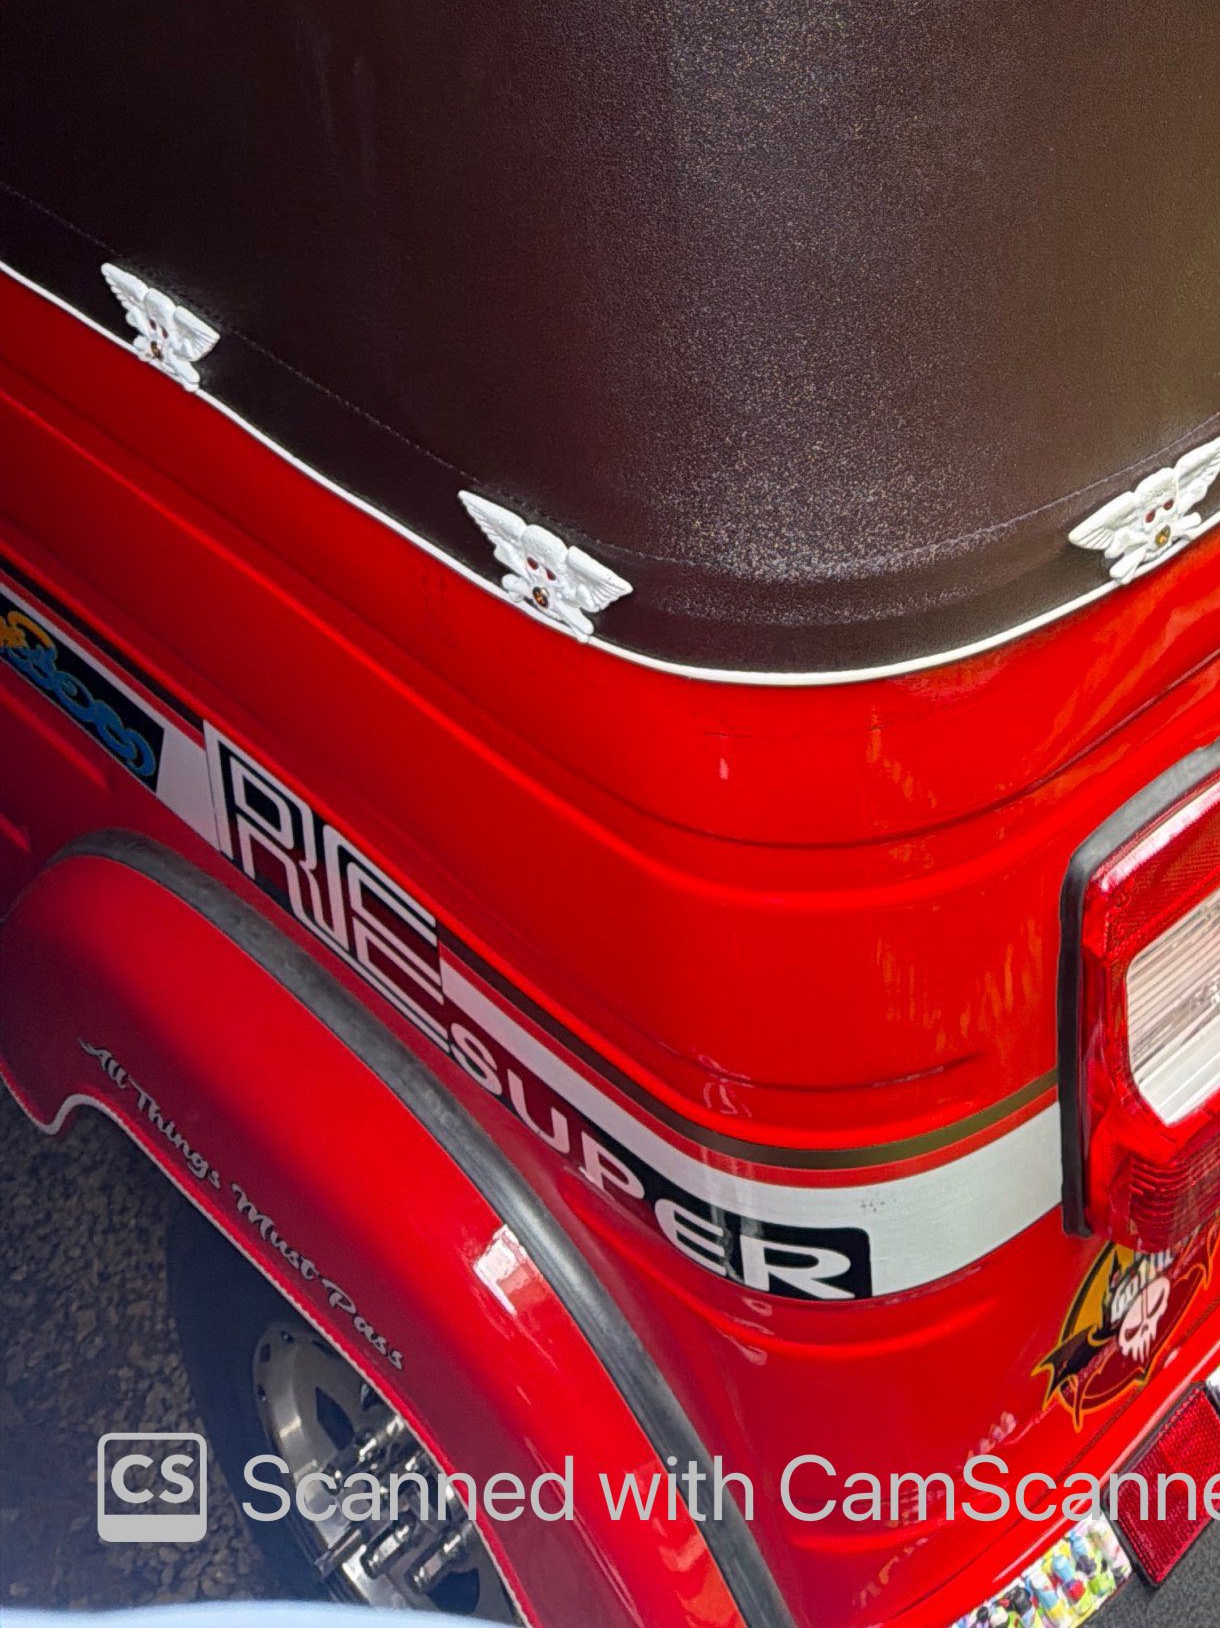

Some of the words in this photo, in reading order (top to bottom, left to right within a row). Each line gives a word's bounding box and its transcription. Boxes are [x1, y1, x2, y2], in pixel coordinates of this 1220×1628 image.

[78, 1037, 127, 1090] All
[128, 1075, 222, 1190] Things
[231, 1182, 320, 1280] Must
[320, 1276, 405, 1370] Pass
[450, 1022, 855, 1301] SUPER
